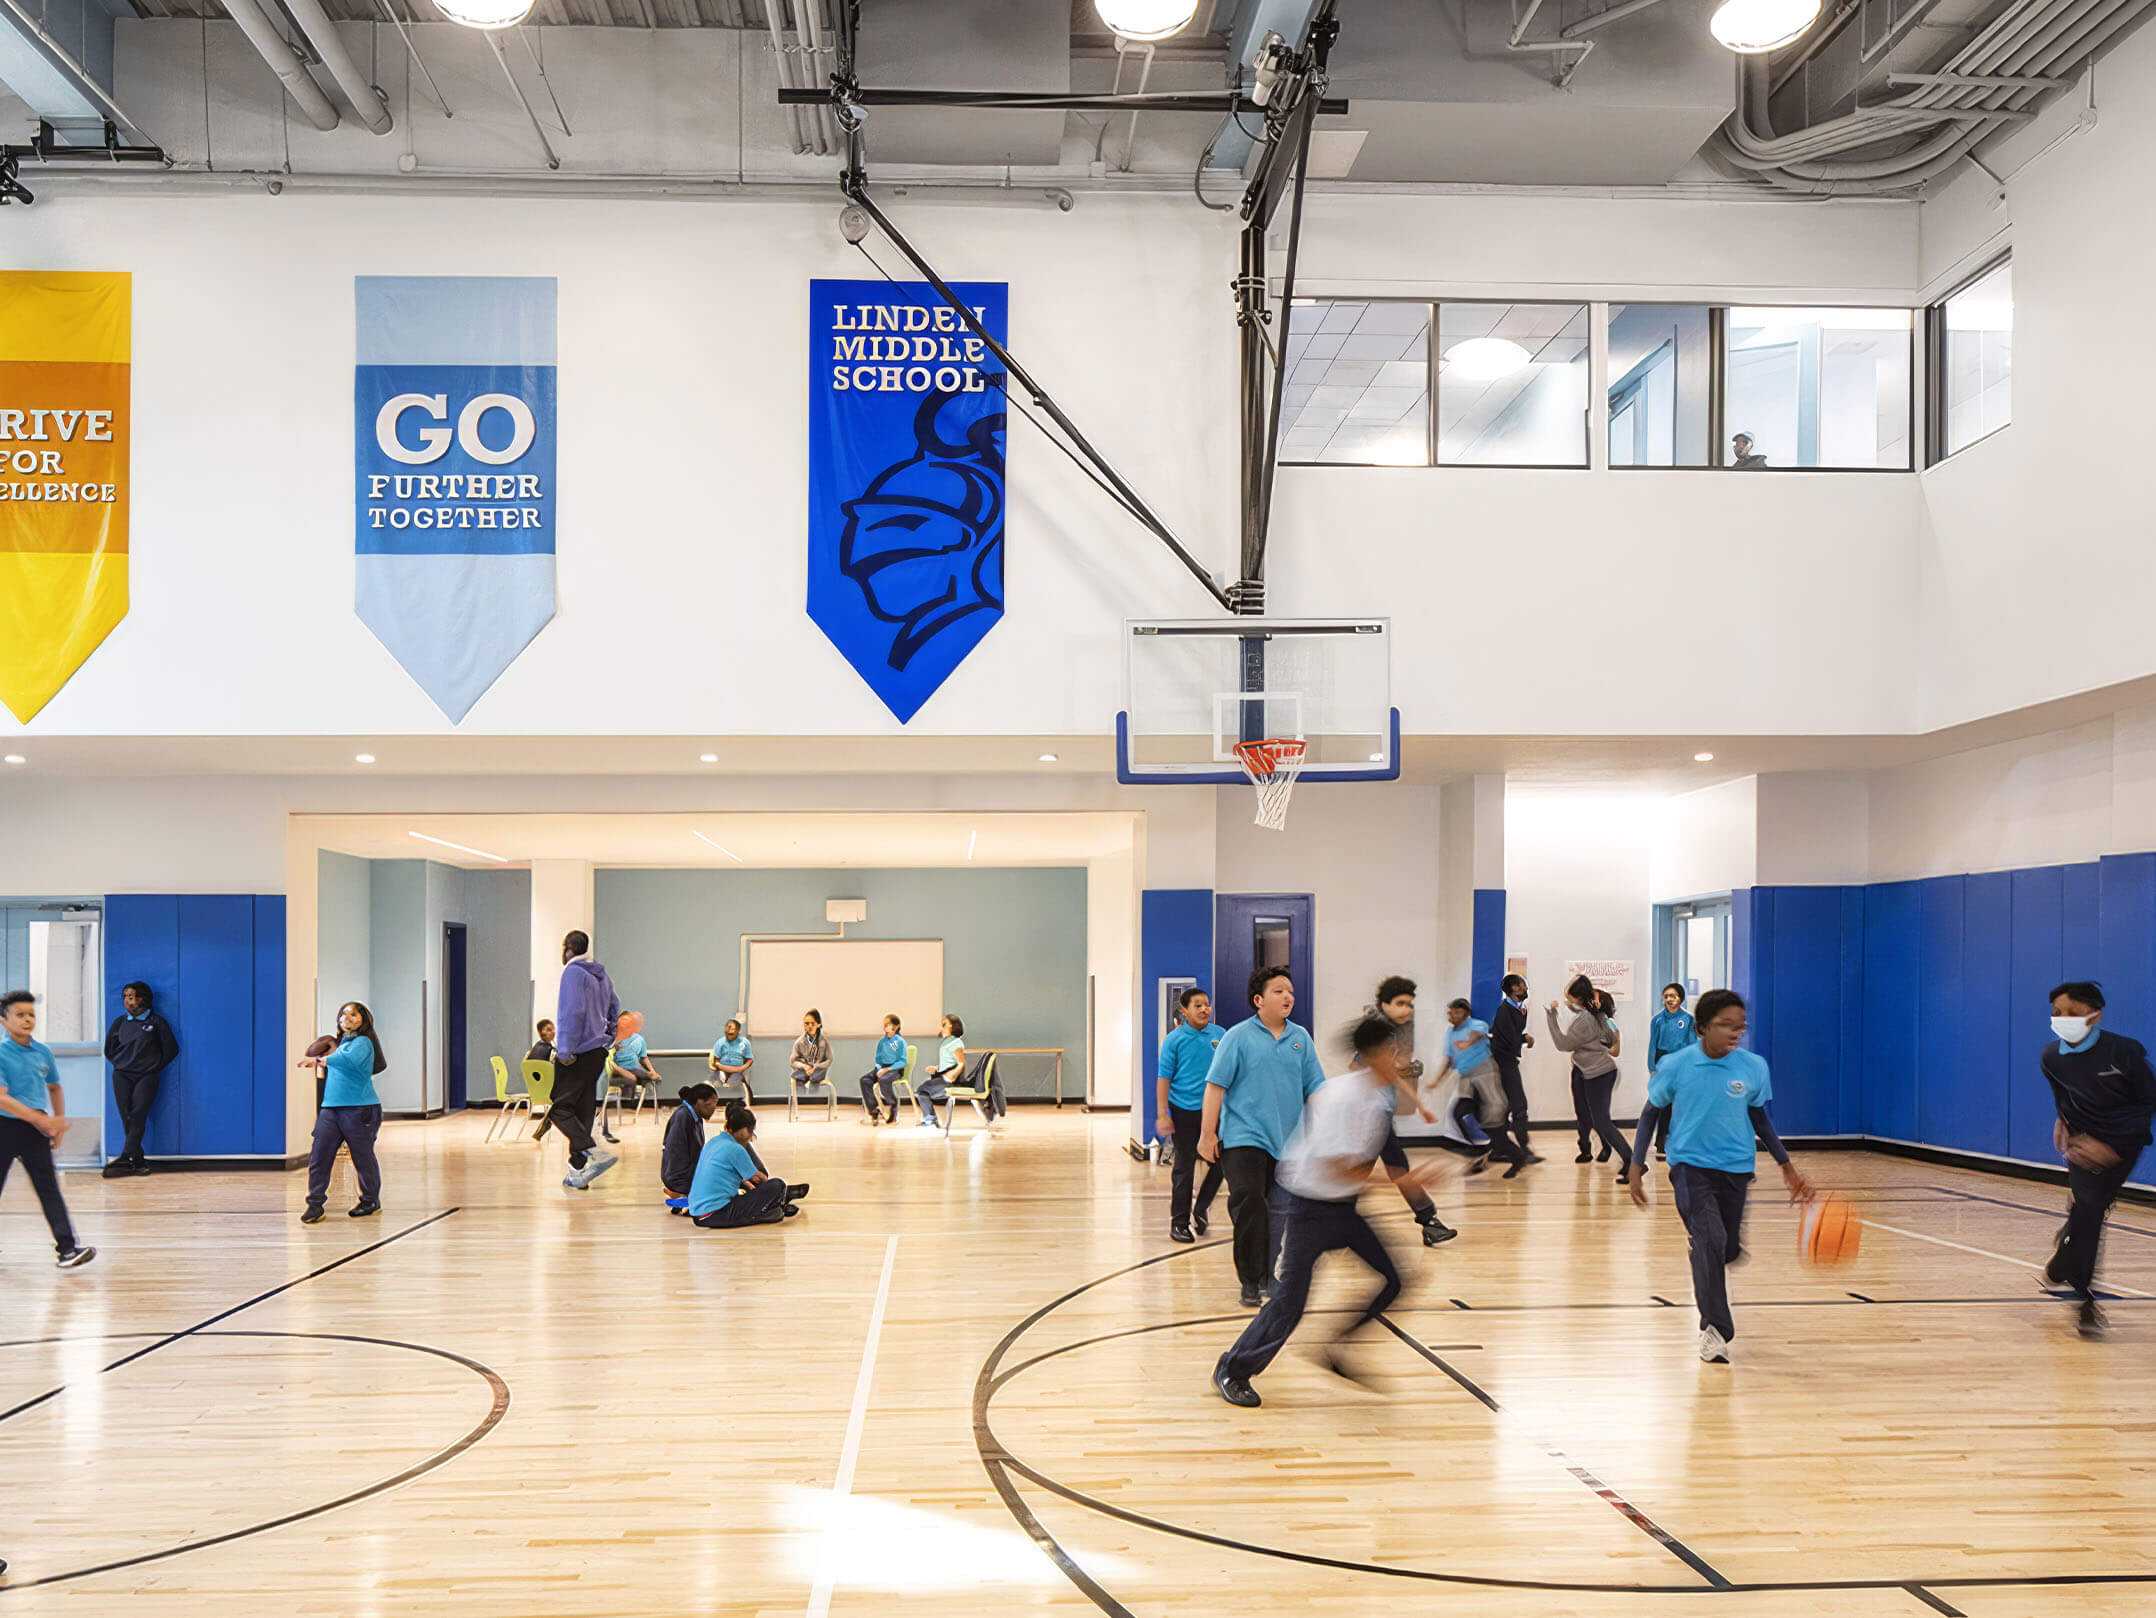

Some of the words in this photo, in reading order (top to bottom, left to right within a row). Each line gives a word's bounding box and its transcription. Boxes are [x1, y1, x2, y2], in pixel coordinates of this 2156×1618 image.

[832, 336, 985, 363] MIDDLE
[832, 366, 985, 393] SCHOOL
[376, 393, 537, 465] GO
[367, 474, 543, 499] FURTHER
[368, 507, 543, 529] TOGETHER
